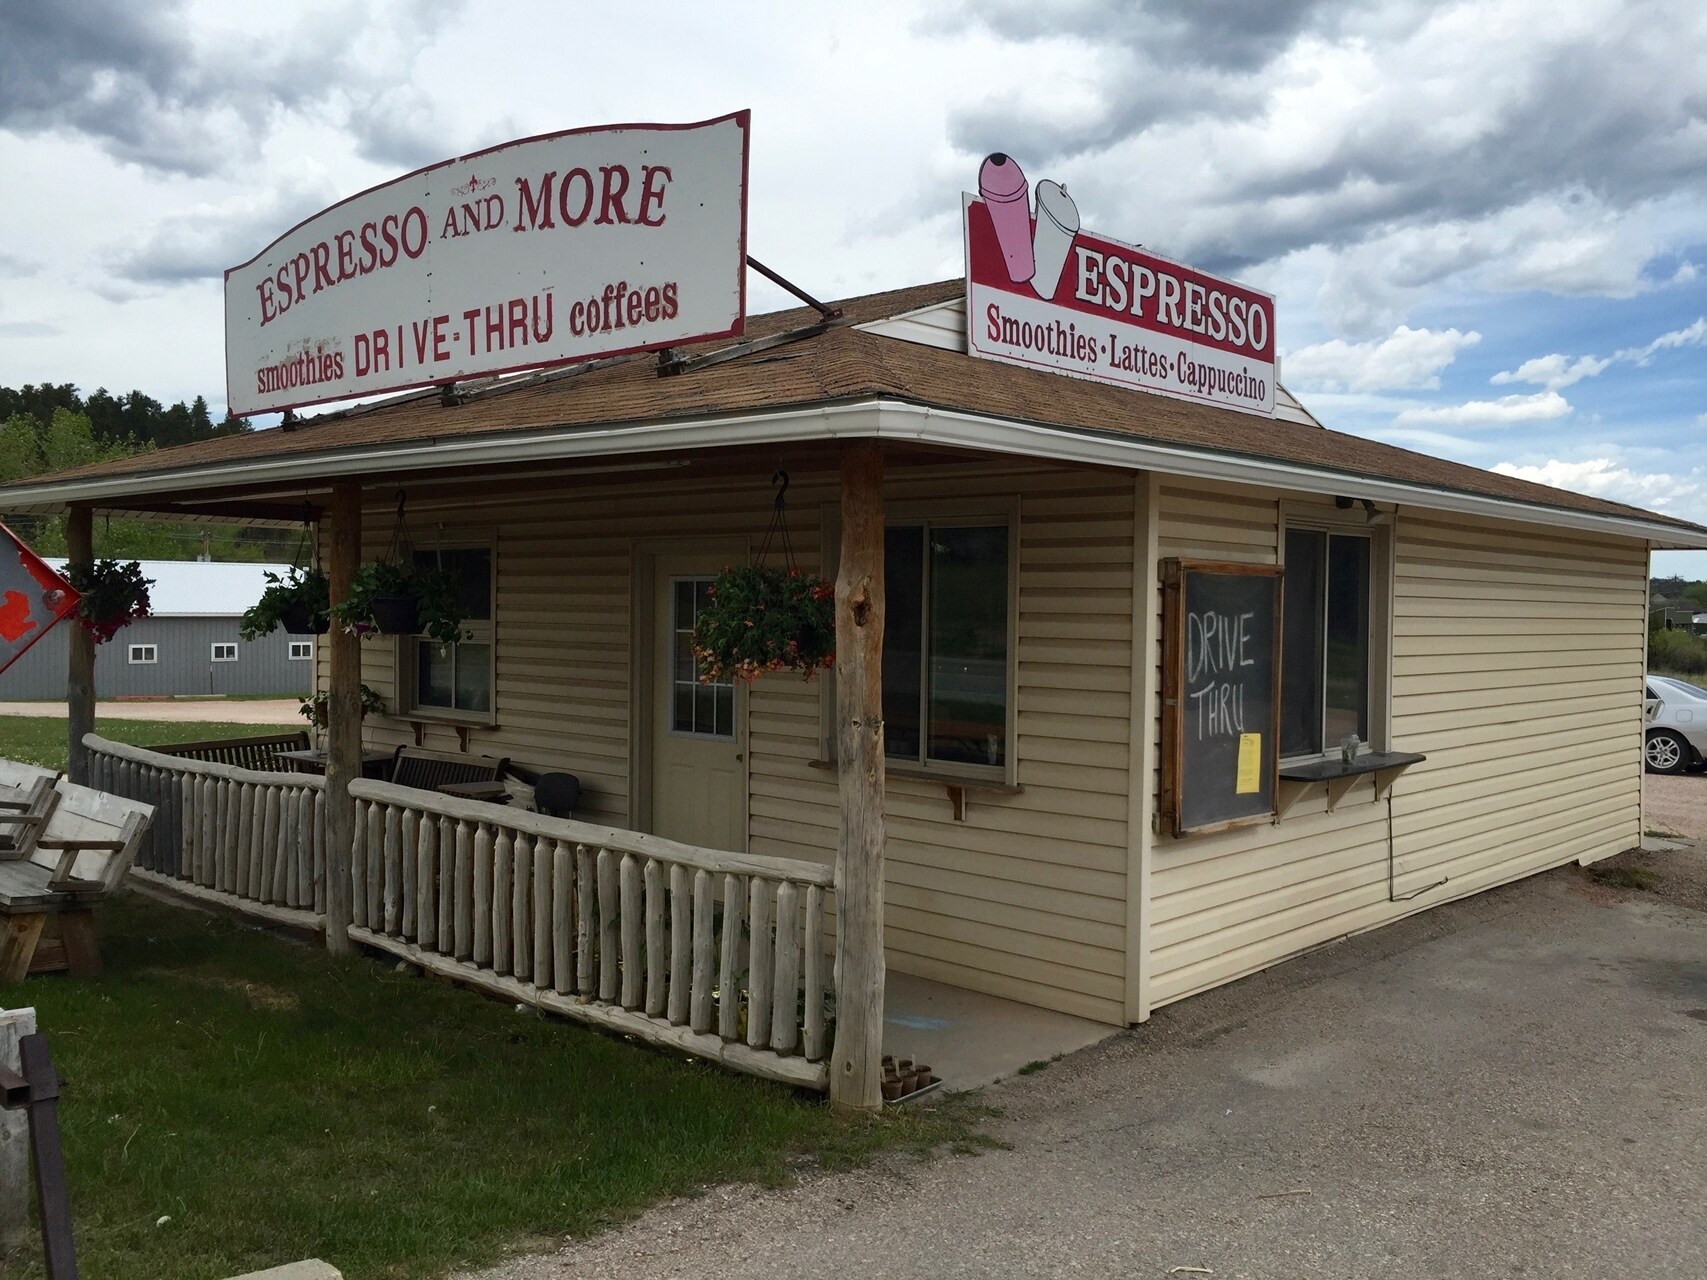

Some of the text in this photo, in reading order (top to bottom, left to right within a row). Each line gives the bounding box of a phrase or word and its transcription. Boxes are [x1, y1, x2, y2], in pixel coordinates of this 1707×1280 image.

[256, 164, 673, 327] ESPRESSO AND MORE
[257, 280, 679, 395] smoothies DRIVE-THRU coffees
[1075, 246, 1268, 351] ESPRESSO
[987, 303, 1266, 402] Smoothies Lattes Cappuccino
[1187, 610, 1255, 684] DRIVE
[1190, 681, 1245, 741] THRU
